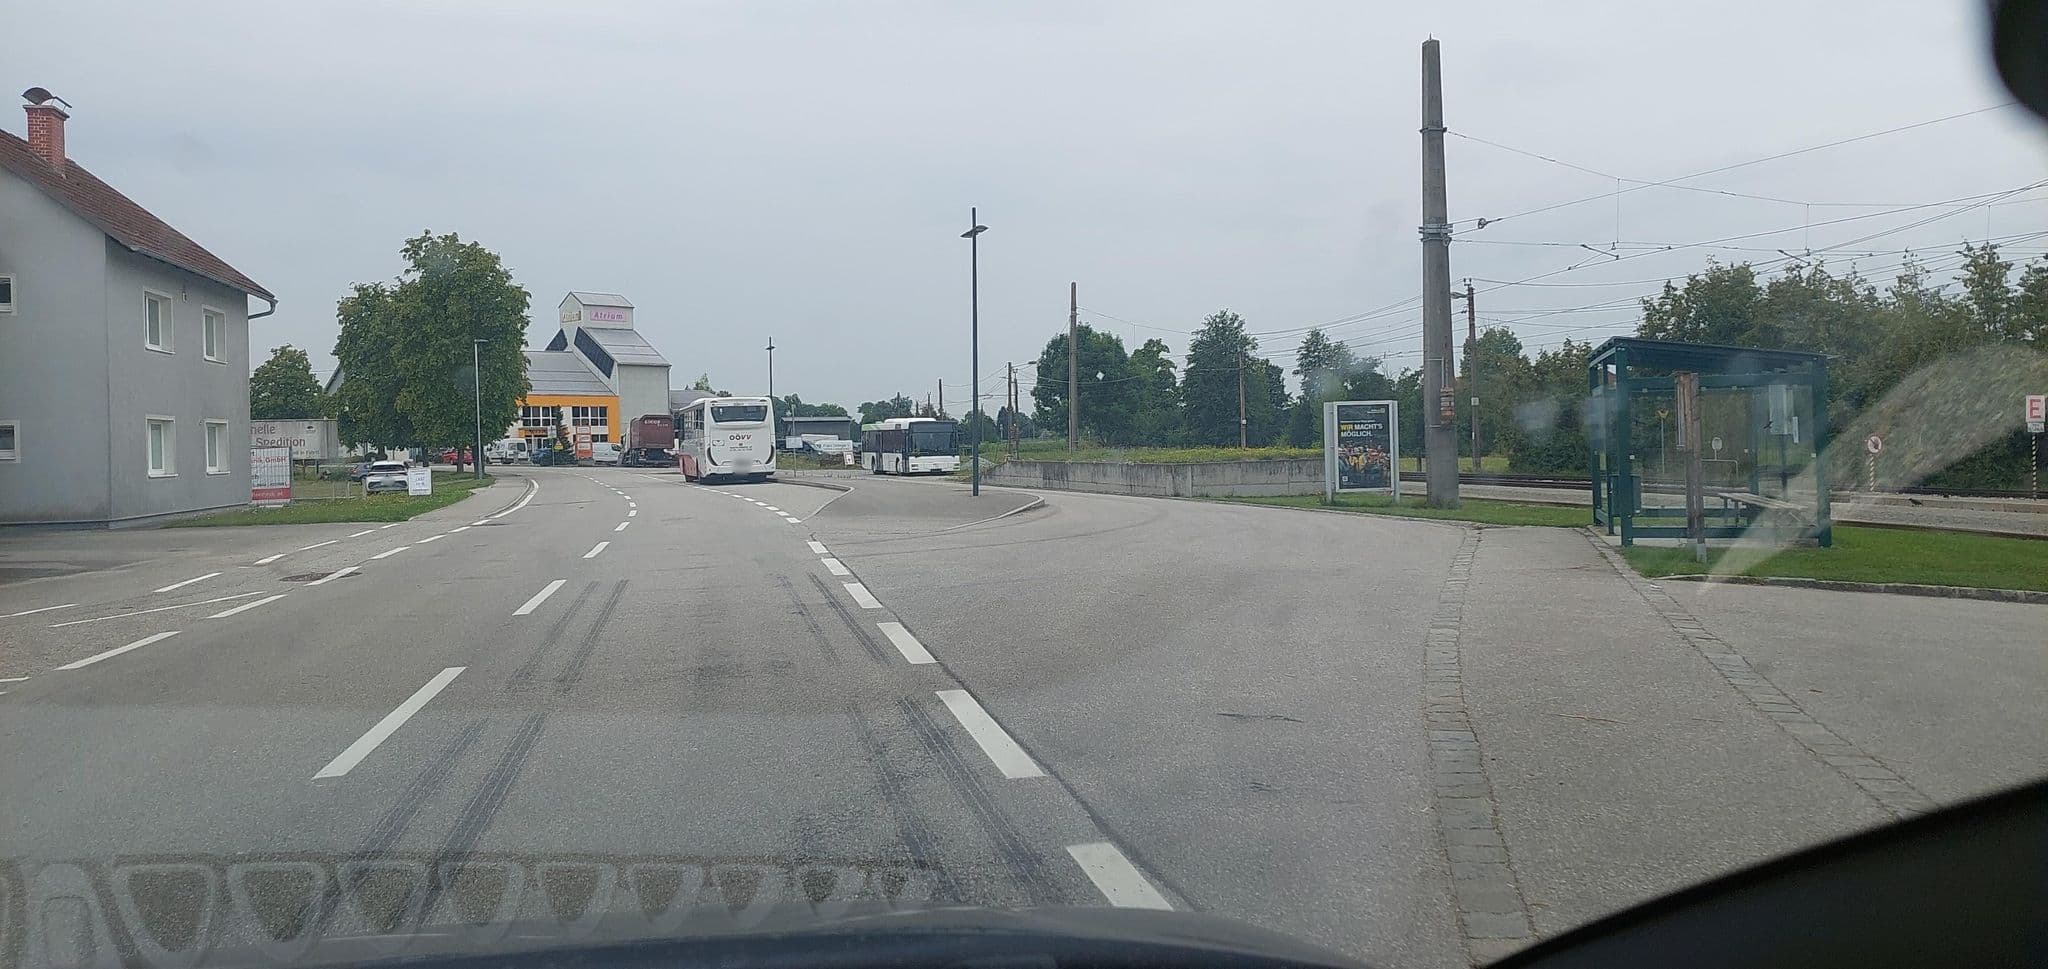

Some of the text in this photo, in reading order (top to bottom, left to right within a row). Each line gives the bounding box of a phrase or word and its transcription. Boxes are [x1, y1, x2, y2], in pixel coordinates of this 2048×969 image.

[594, 312, 623, 320] Atrium
[2030, 399, 2041, 418] E
[256, 436, 306, 448] Spedition
